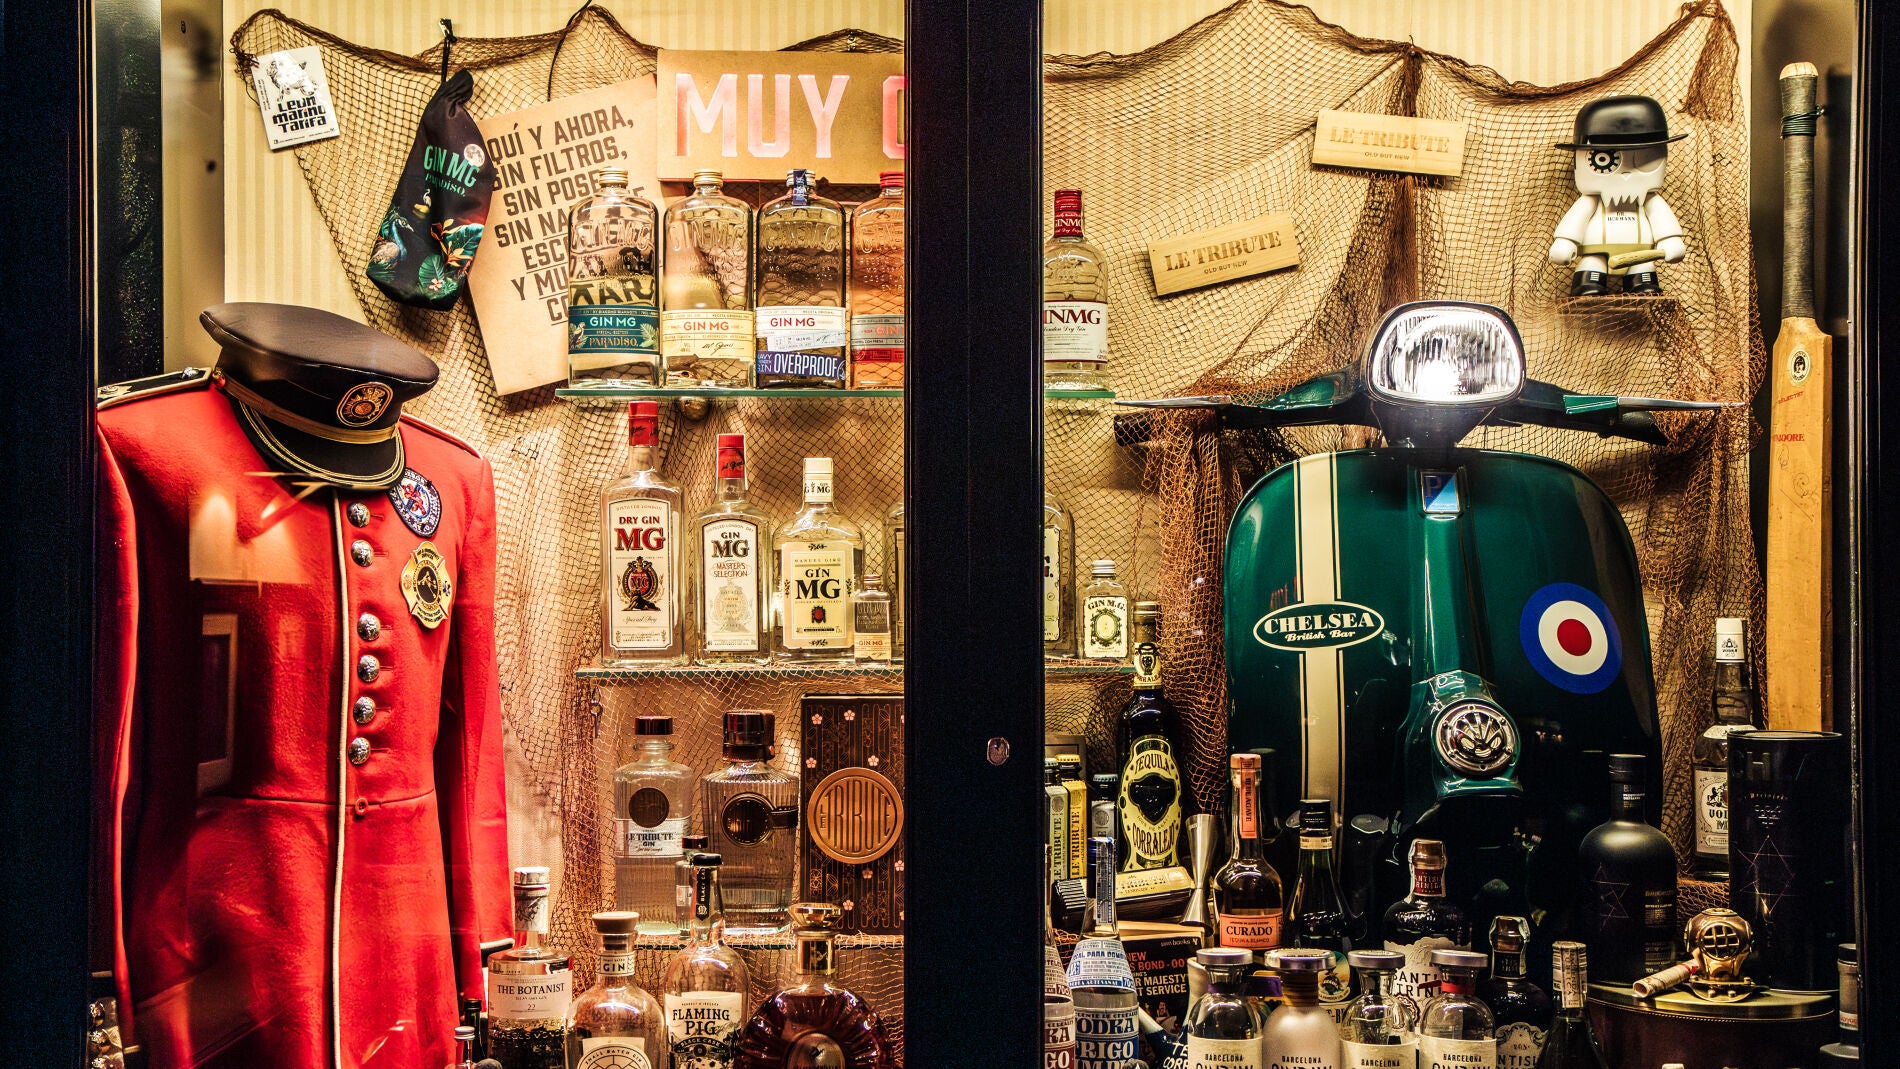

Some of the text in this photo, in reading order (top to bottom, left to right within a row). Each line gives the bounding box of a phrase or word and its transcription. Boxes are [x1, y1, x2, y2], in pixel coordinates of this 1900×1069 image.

[676, 73, 850, 158] MUY
[528, 125, 543, 150] Y
[554, 105, 634, 146] AHORA,
[1330, 127, 1450, 153] LE TRIBUTE
[530, 136, 628, 180] FILTROS,
[424, 145, 481, 188] GIN MG
[503, 183, 542, 217] SIN
[494, 217, 534, 248] SIN
[1164, 231, 1282, 271] LE TRIBUTE
[510, 276, 526, 301] Y
[590, 316, 636, 327] GIN MG
[683, 321, 729, 331] GIN MG
[770, 317, 816, 327] GIN MG
[875, 325, 899, 336] GIN
[773, 353, 838, 378] OVERPROOF
[619, 516, 660, 525] DRY GIN
[614, 527, 666, 551] MG
[721, 531, 740, 539] GIN
[711, 540, 750, 558] MG
[714, 570, 748, 578] SELECTION
[805, 568, 830, 578] GIN
[795, 579, 841, 600] MG
[1087, 599, 1126, 611] GIN M.G.
[1264, 612, 1375, 635] CHELSEA
[1285, 629, 1356, 642] British Bar
[1134, 753, 1172, 775] TEQUILA
[824, 778, 891, 853] TRIBUTE
[637, 833, 674, 841] TRIBUTE
[1054, 818, 1062, 867] TRIBUTE
[1072, 811, 1080, 876] LE TRIBUTE
[1132, 822, 1175, 856] CORRALEJO
[1226, 926, 1273, 936] CURADO
[603, 963, 626, 972] GIN
[1138, 959, 1165, 971] BOND
[1144, 973, 1186, 986] MAJESTY
[497, 983, 565, 995] THE BOTANIST
[1146, 983, 1187, 996] SERVICE
[527, 1003, 536, 1011] 22
[672, 1008, 731, 1021] FLAMING
[685, 1020, 717, 1035] PIG
[681, 1038, 700, 1047] BLACK
[585, 1051, 603, 1065] SMALL
[632, 1054, 643, 1063] GIN
[1205, 1053, 1244, 1062] BARCELONA
[1281, 1055, 1322, 1063] BARCELONA
[1361, 1058, 1400, 1068] BARCELONA
[1443, 1053, 1482, 1063] BARCELONA
